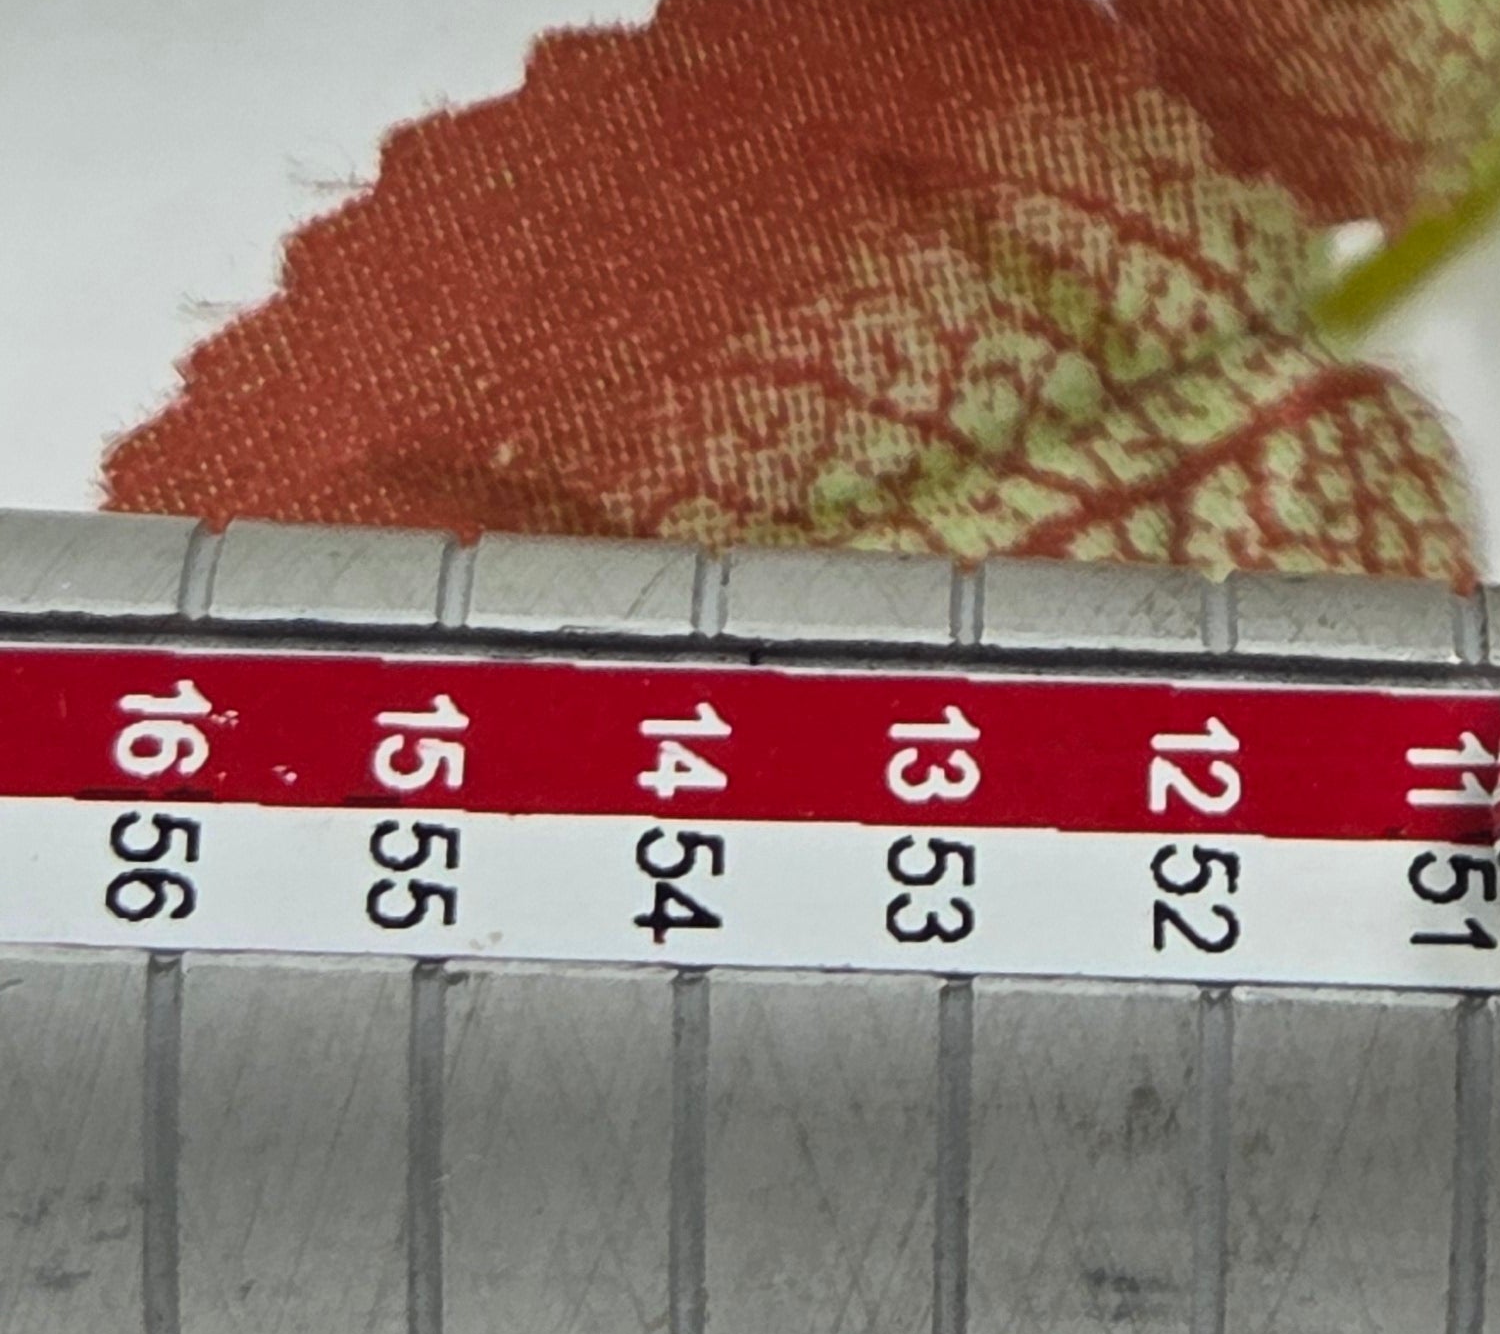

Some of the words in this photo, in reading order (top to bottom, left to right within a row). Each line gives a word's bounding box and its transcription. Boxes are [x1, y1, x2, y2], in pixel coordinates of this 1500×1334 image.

[114, 679, 212, 778] 16
[373, 694, 470, 791] 15
[637, 702, 732, 799] 14
[885, 705, 982, 805] 13
[1147, 717, 1242, 815] 12
[1405, 731, 1500, 806] 11
[105, 812, 201, 923] 56
[365, 819, 461, 930] 55
[633, 827, 726, 944] 54
[885, 835, 976, 944] 53
[1150, 844, 1241, 955] 52
[1408, 851, 1498, 949] 51
